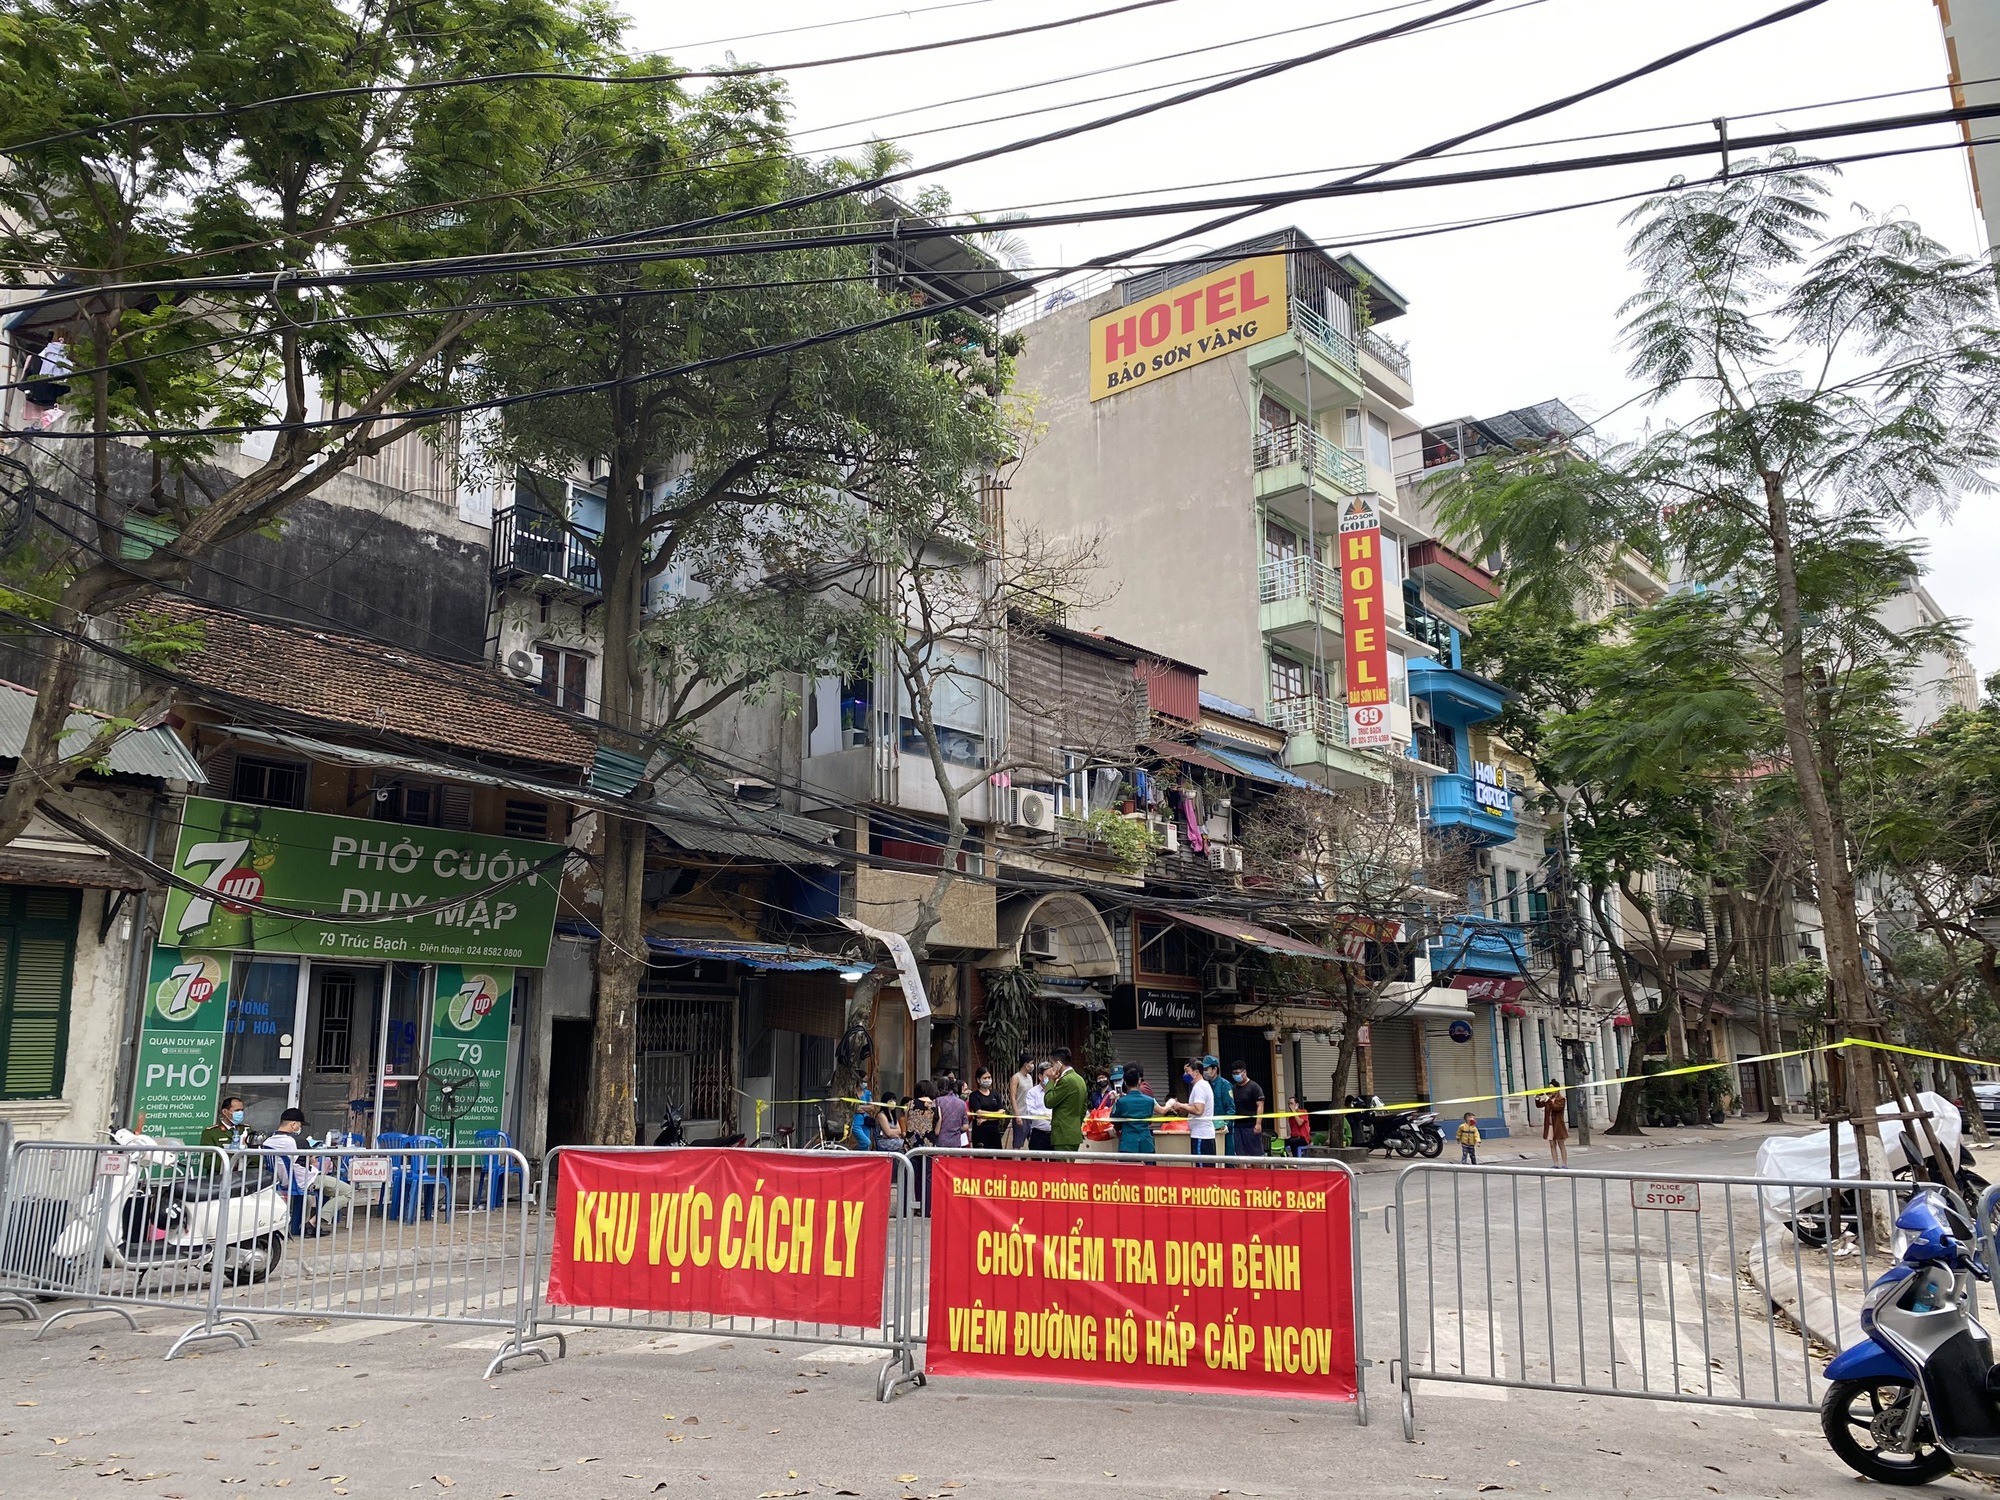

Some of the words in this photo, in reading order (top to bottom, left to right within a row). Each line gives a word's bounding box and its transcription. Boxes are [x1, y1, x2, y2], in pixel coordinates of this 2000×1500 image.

[1106, 270, 1270, 364] HOTEL
[1107, 361, 1147, 389] BẢO
[1151, 344, 1192, 372] SƠN
[1197, 320, 1259, 354] VÀNG
[1340, 519, 1379, 532] GOLD
[1349, 535, 1378, 683] HOTEL
[1359, 708, 1379, 724] 89
[329, 836, 424, 873] PHỞ
[433, 848, 541, 887] CUỐN
[340, 888, 428, 923] DUY
[319, 932, 336, 947] 79
[340, 933, 370, 949] Trúc
[373, 935, 408, 953] Bạch
[419, 943, 440, 957] Điện
[441, 944, 466, 955] thoại:
[466, 945, 482, 955] 024
[483, 946, 502, 957] 8582
[503, 948, 523, 958] 0800
[177, 1038, 196, 1046] DUY
[457, 1043, 482, 1065] 79
[145, 1057, 214, 1088] PHỞ
[104, 1163, 120, 1171] STOP
[953, 1176, 981, 1196] BAN
[984, 1174, 1007, 1197] CHỈ
[1010, 1180, 1038, 1202] ĐẠO
[1042, 1177, 1088, 1201] PHÒNG
[1093, 1177, 1140, 1204] CHỐNG
[1145, 1187, 1178, 1207] DỊCH
[1182, 1185, 1241, 1207] PHƯỜNG
[1246, 1186, 1282, 1209] TRÚC
[1287, 1191, 1327, 1212] BẠCH
[1646, 1193, 1686, 1205] STOP
[573, 1190, 640, 1265] KHU
[649, 1185, 713, 1284] VỰC
[718, 1178, 815, 1275] CÁCH
[823, 1199, 865, 1278] LY
[977, 1217, 1037, 1277] CHỐT
[1044, 1217, 1105, 1282] KIỂM
[1112, 1238, 1158, 1285] TRA
[1165, 1240, 1224, 1297] DỊCH
[1232, 1234, 1301, 1300] BỆNH
[948, 1299, 1006, 1355] VIÊM
[1014, 1302, 1097, 1362] ĐƯỜNG
[1105, 1309, 1138, 1364] HÔ
[1146, 1304, 1196, 1368] HẤP
[1204, 1307, 1256, 1371] CẤP
[1264, 1325, 1332, 1375] NCOV
